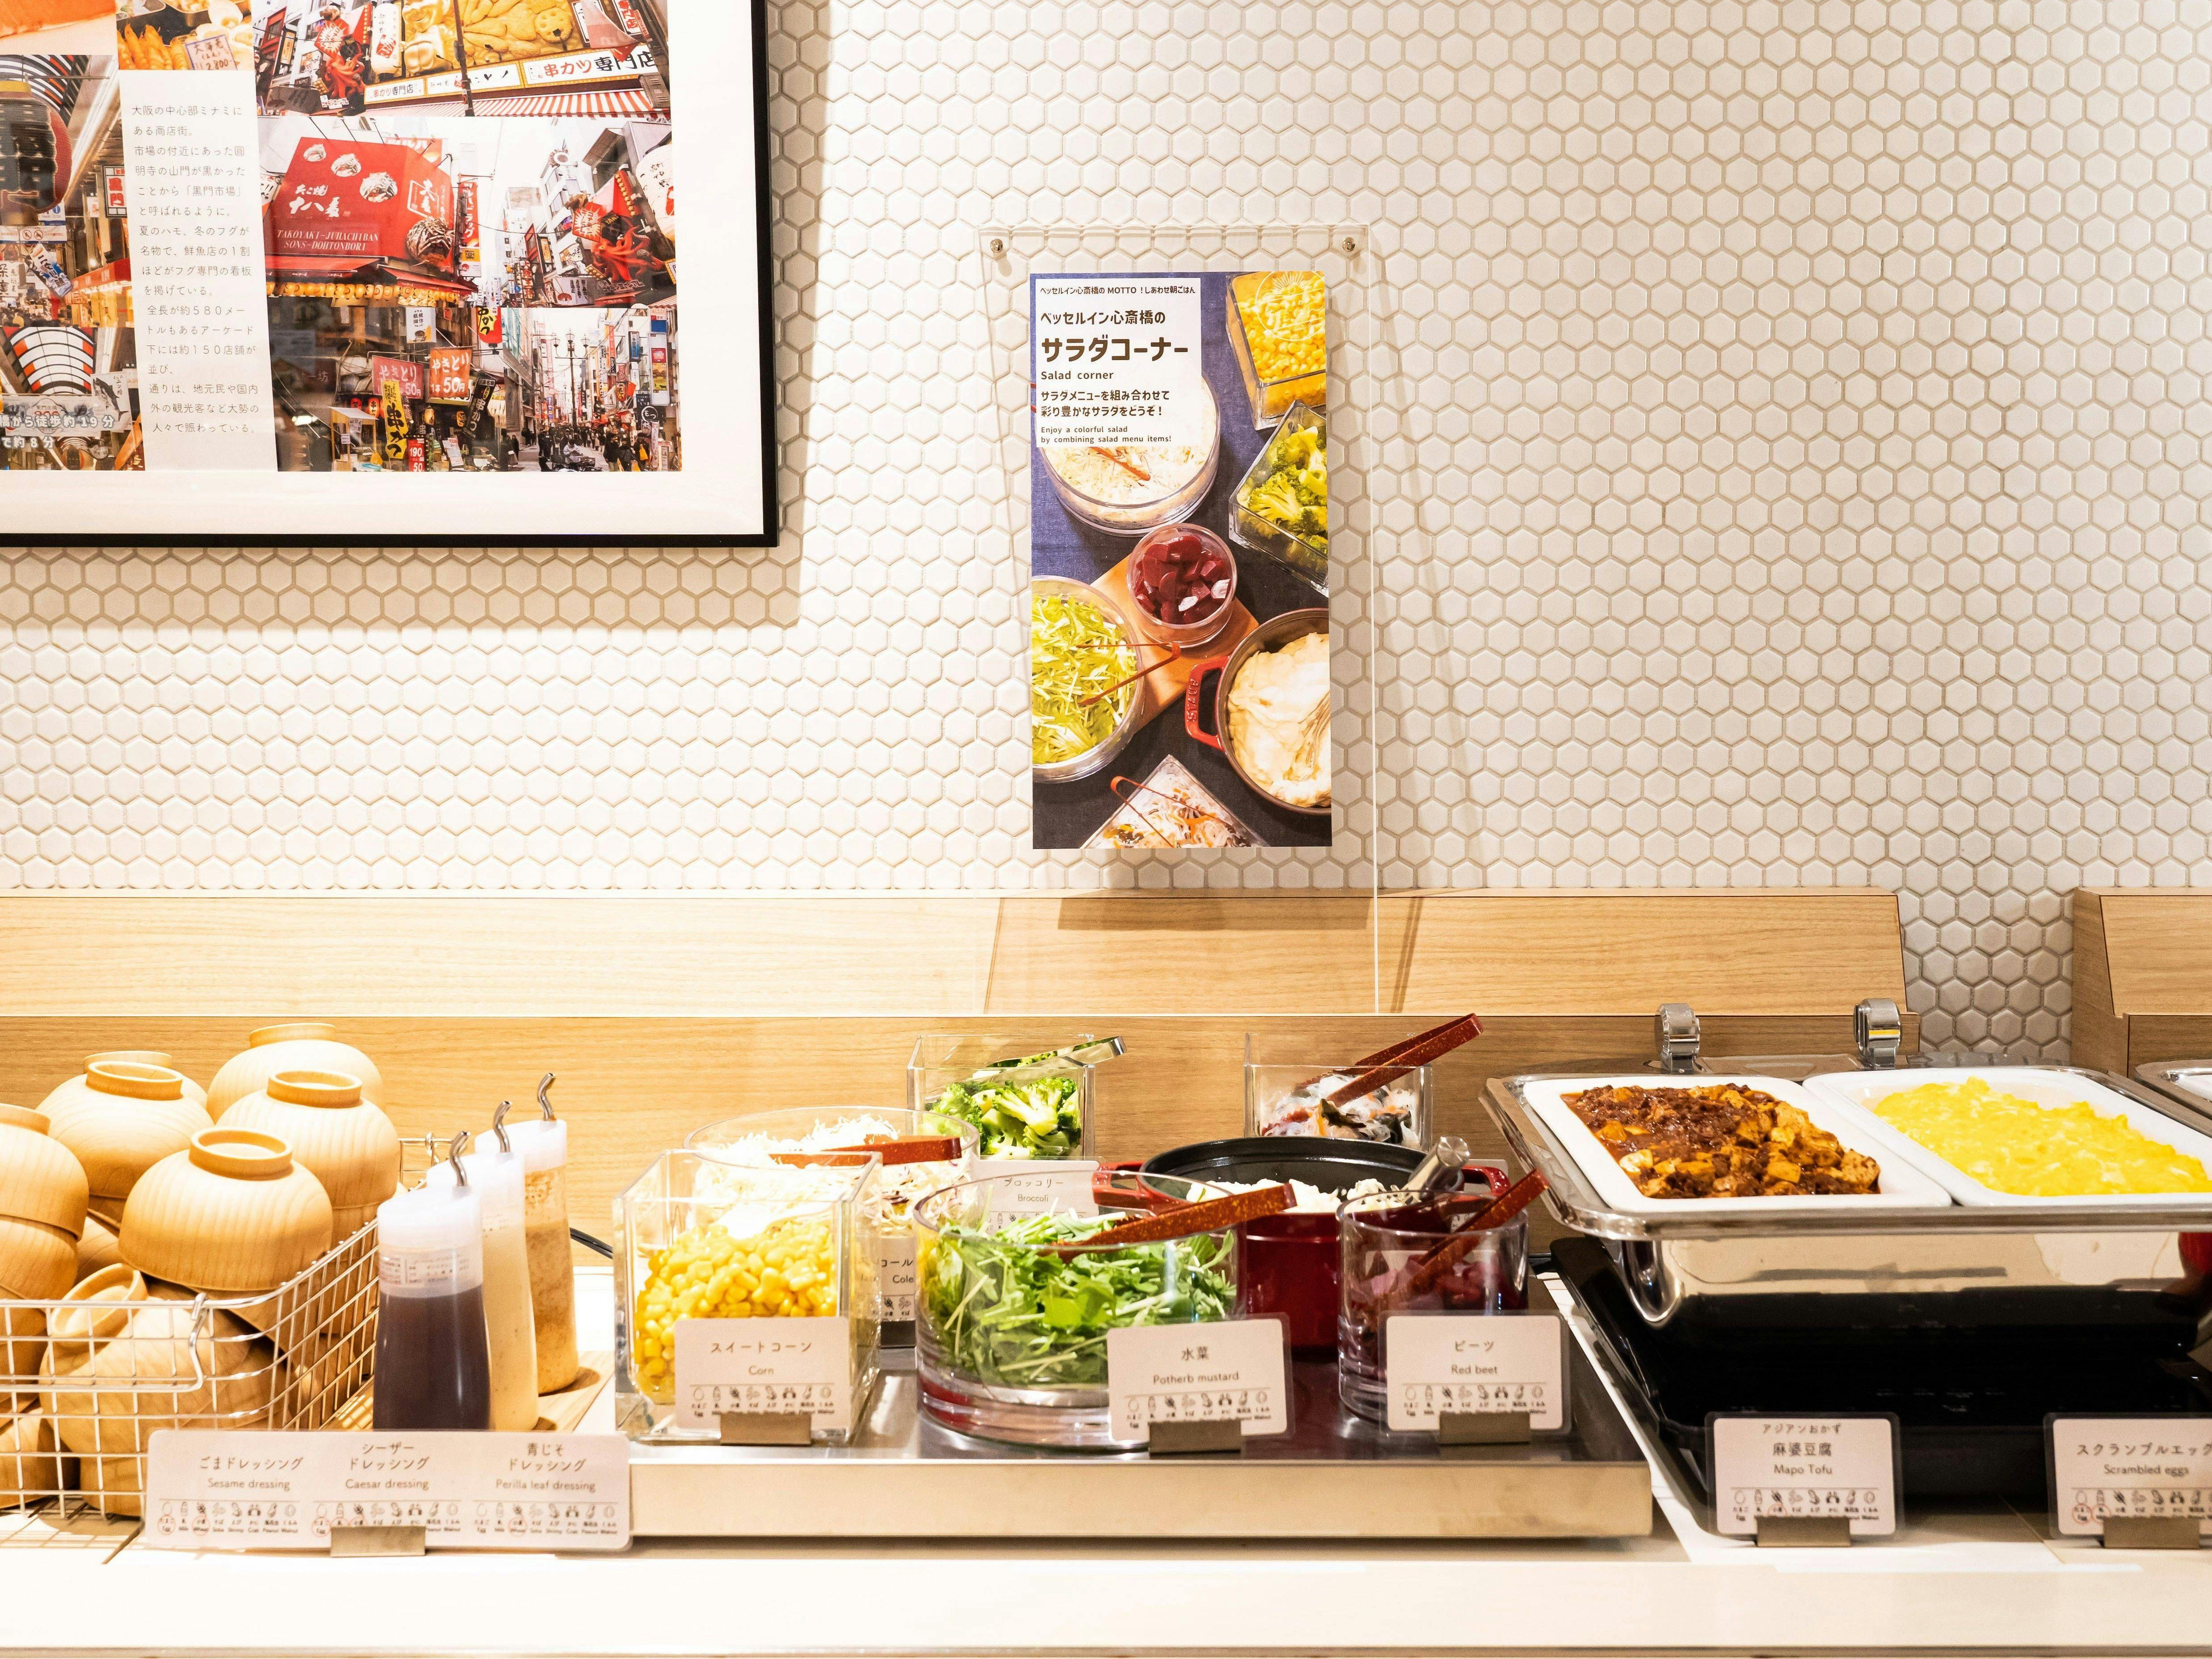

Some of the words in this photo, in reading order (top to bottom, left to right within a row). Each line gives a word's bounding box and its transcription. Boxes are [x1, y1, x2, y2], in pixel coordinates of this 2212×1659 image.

[132, 105, 242, 116] 大阪の中心部ミナミに
[134, 126, 192, 136] ある商店街。
[135, 166, 245, 176] 明寺の山門が黒かった
[139, 185, 241, 197] ことから「黒門市場」
[139, 206, 230, 216] と呼ばれるように。
[139, 226, 249, 236] 夏のハモ、冬のフグが
[142, 265, 252, 276] ほどがフグ専門の看板
[144, 285, 213, 296] を掲げている。
[1041, 286, 1105, 295] ベッセルイン心斎橋の
[147, 305, 245, 316] 全長が約５８０メー
[1041, 310, 1166, 325] ベッセルイン心斎橋の
[148, 325, 253, 335] トルもあるアーケード
[1042, 334, 1189, 362] サラダコーナー
[148, 364, 173, 374] 並び、
[431, 352, 470, 375] やきとり
[1041, 371, 1071, 380] Salad
[1078, 372, 1114, 380] corner
[149, 384, 258, 395] 通りは、地元民や国内
[1041, 390, 1170, 401] サラダメニューを組み合わせて
[151, 403, 259, 414] 外の観光客など大勢の
[1041, 405, 1163, 417] 彩り豊かなサラダをどうぞ！
[80, 416, 98, 428] 19
[102, 415, 115, 428] 分
[1041, 427, 1062, 435] Enjoy
[29, 437, 38, 449] 8
[42, 435, 55, 449] 分
[1041, 436, 1050, 445] by
[1054, 436, 1095, 444] combining
[410, 447, 423, 457] 190
[1004, 1178, 1064, 1189] ブロッコリー
[1018, 1194, 1049, 1203] Broccoli
[711, 1341, 813, 1354] スイートコーン
[748, 1365, 775, 1377] Corn
[1451, 1364, 1472, 1375] Red
[1475, 1365, 1498, 1375] beet
[1153, 1373, 1195, 1386] Potherb
[1198, 1371, 1240, 1383] mustard
[362, 1442, 415, 1455] シーザー
[528, 1443, 564, 1457] 青じそ
[1772, 1442, 1833, 1457] 麻婆豆腐
[200, 1456, 304, 1471] ごまドレッシング
[351, 1456, 430, 1472] ドレッシング
[508, 1458, 588, 1473] ドレッシング
[1774, 1464, 1805, 1476] Mapo
[1808, 1464, 1834, 1475] Tofu
[2104, 1464, 2162, 1475] Scrambled
[2165, 1467, 2190, 1478] eggs
[208, 1478, 245, 1489] Sesame
[248, 1479, 291, 1491] dressing
[345, 1479, 381, 1489] Caesar
[386, 1479, 430, 1491] dressing
[496, 1478, 528, 1490] Perilla
[531, 1479, 550, 1490] leaf
[553, 1480, 597, 1493] dressing
